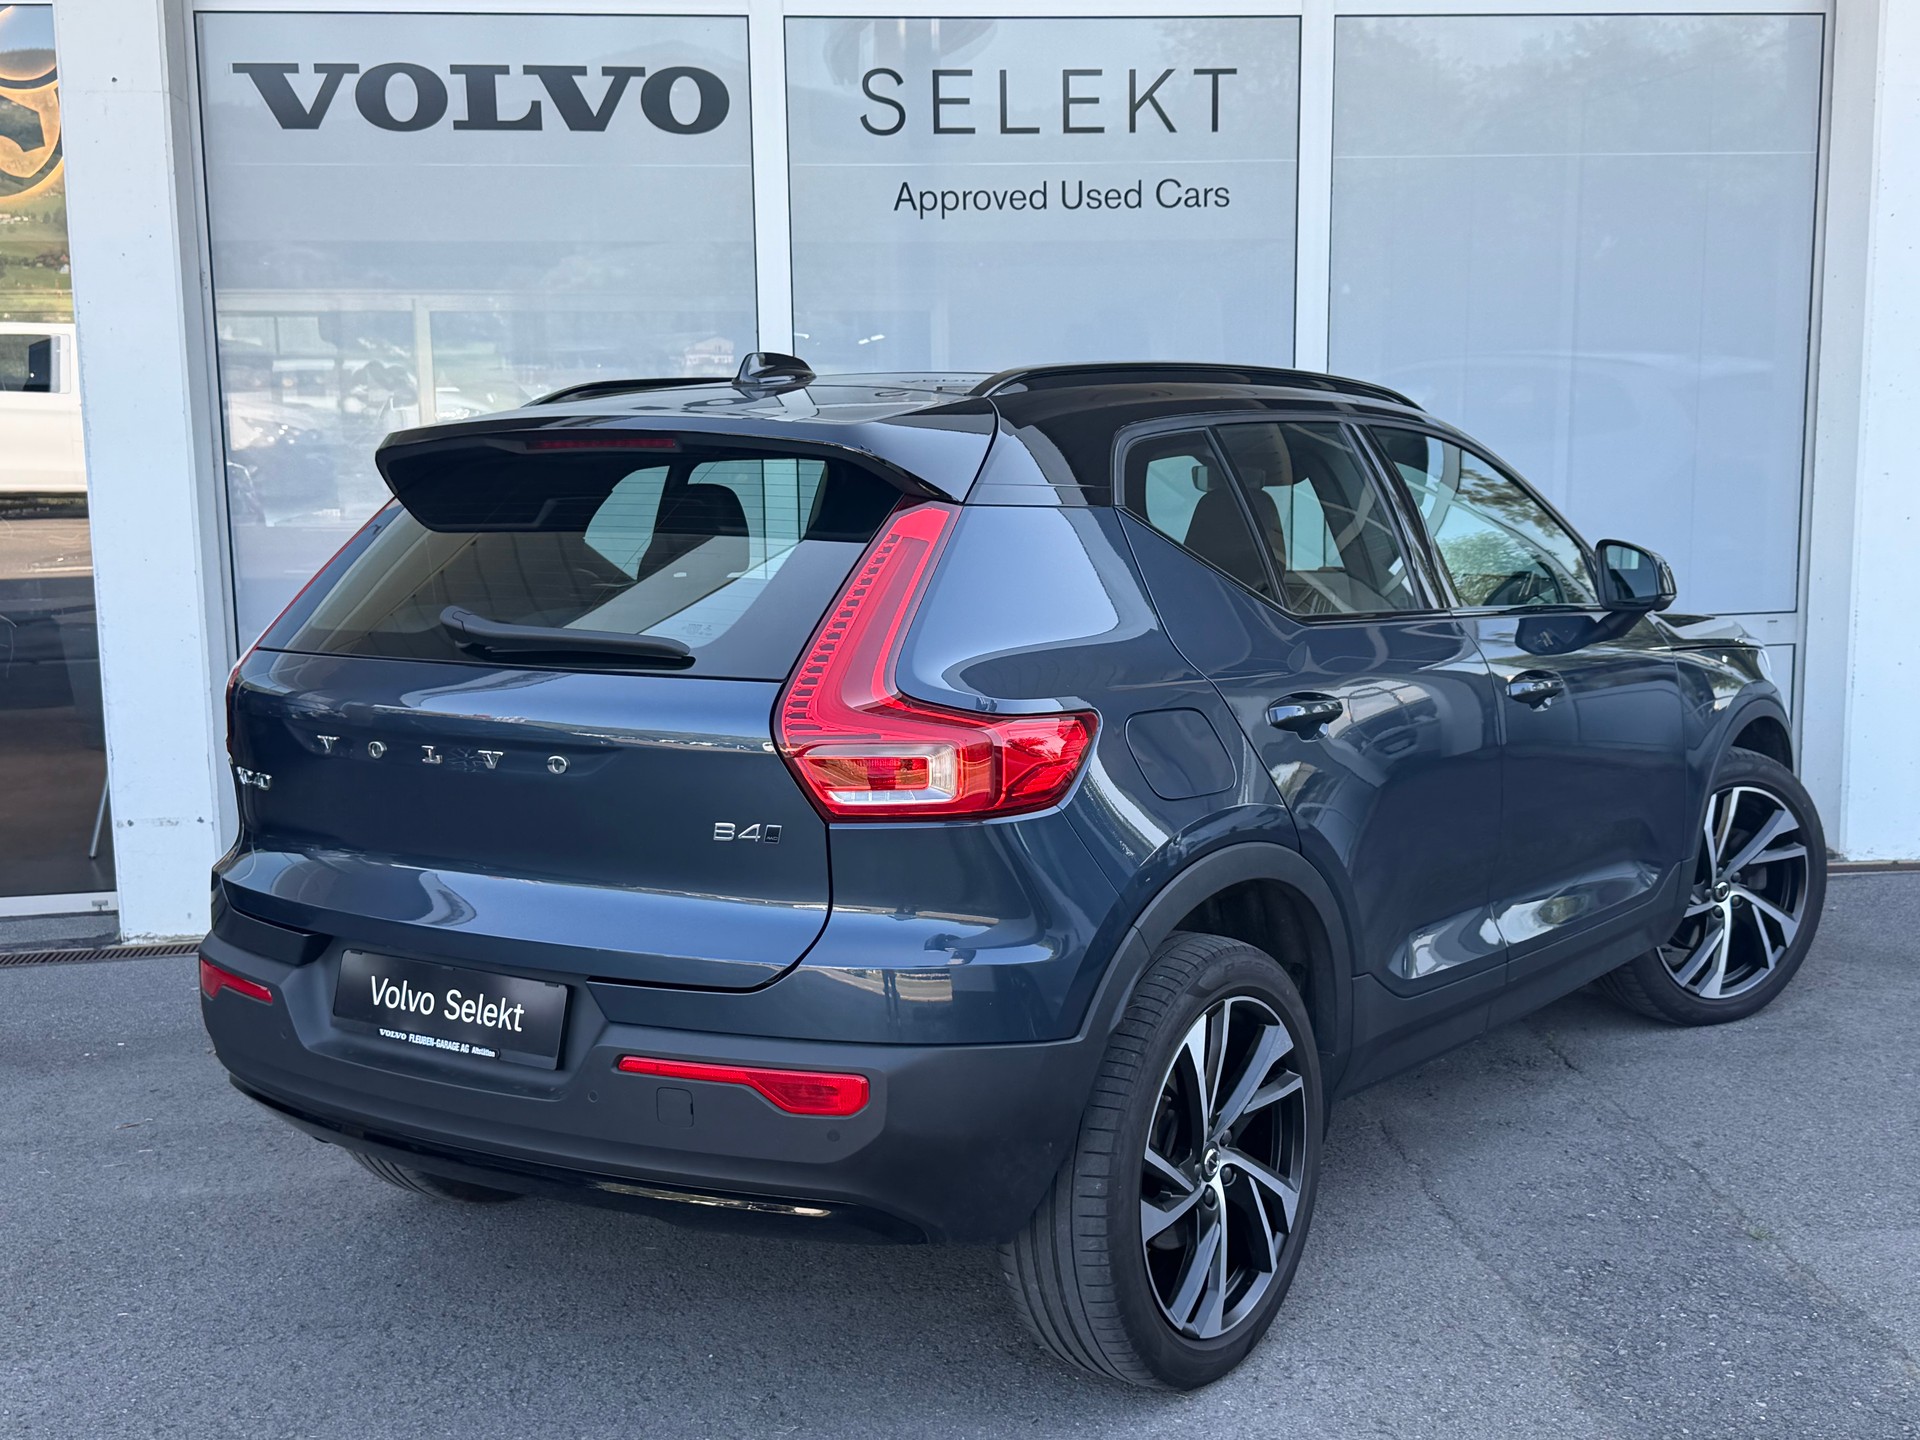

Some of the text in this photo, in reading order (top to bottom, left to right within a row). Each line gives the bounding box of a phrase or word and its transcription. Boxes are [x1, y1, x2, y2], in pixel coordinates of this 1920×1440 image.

[231, 61, 730, 135] VOLVO
[860, 67, 1238, 136] SELEKT
[893, 178, 1230, 219] Approved Used Cars
[316, 735, 571, 775] VOLVO
[713, 822, 761, 842] B4
[370, 975, 525, 1032] Volvo Selekt
[379, 1028, 407, 1041] VOLVO
[460, 1043, 470, 1054] AG
